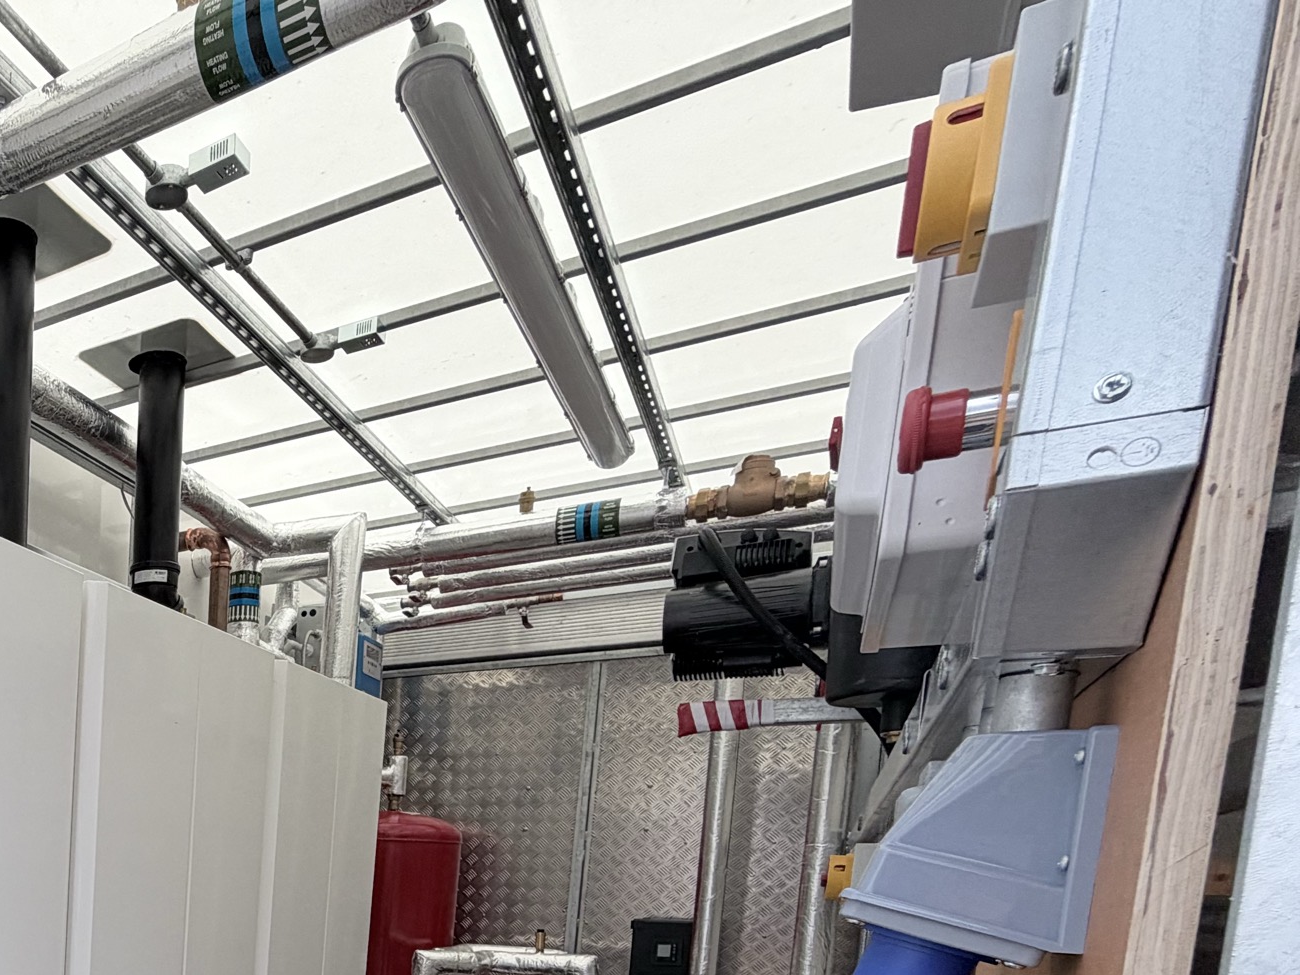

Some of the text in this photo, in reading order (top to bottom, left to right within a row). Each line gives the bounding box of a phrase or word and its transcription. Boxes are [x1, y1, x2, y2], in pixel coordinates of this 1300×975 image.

[206, 3, 221, 16] FLOW
[205, 20, 220, 33] FLOW
[202, 28, 224, 46] HEATING
[206, 51, 228, 67] HEATING
[212, 62, 227, 75] FLOW
